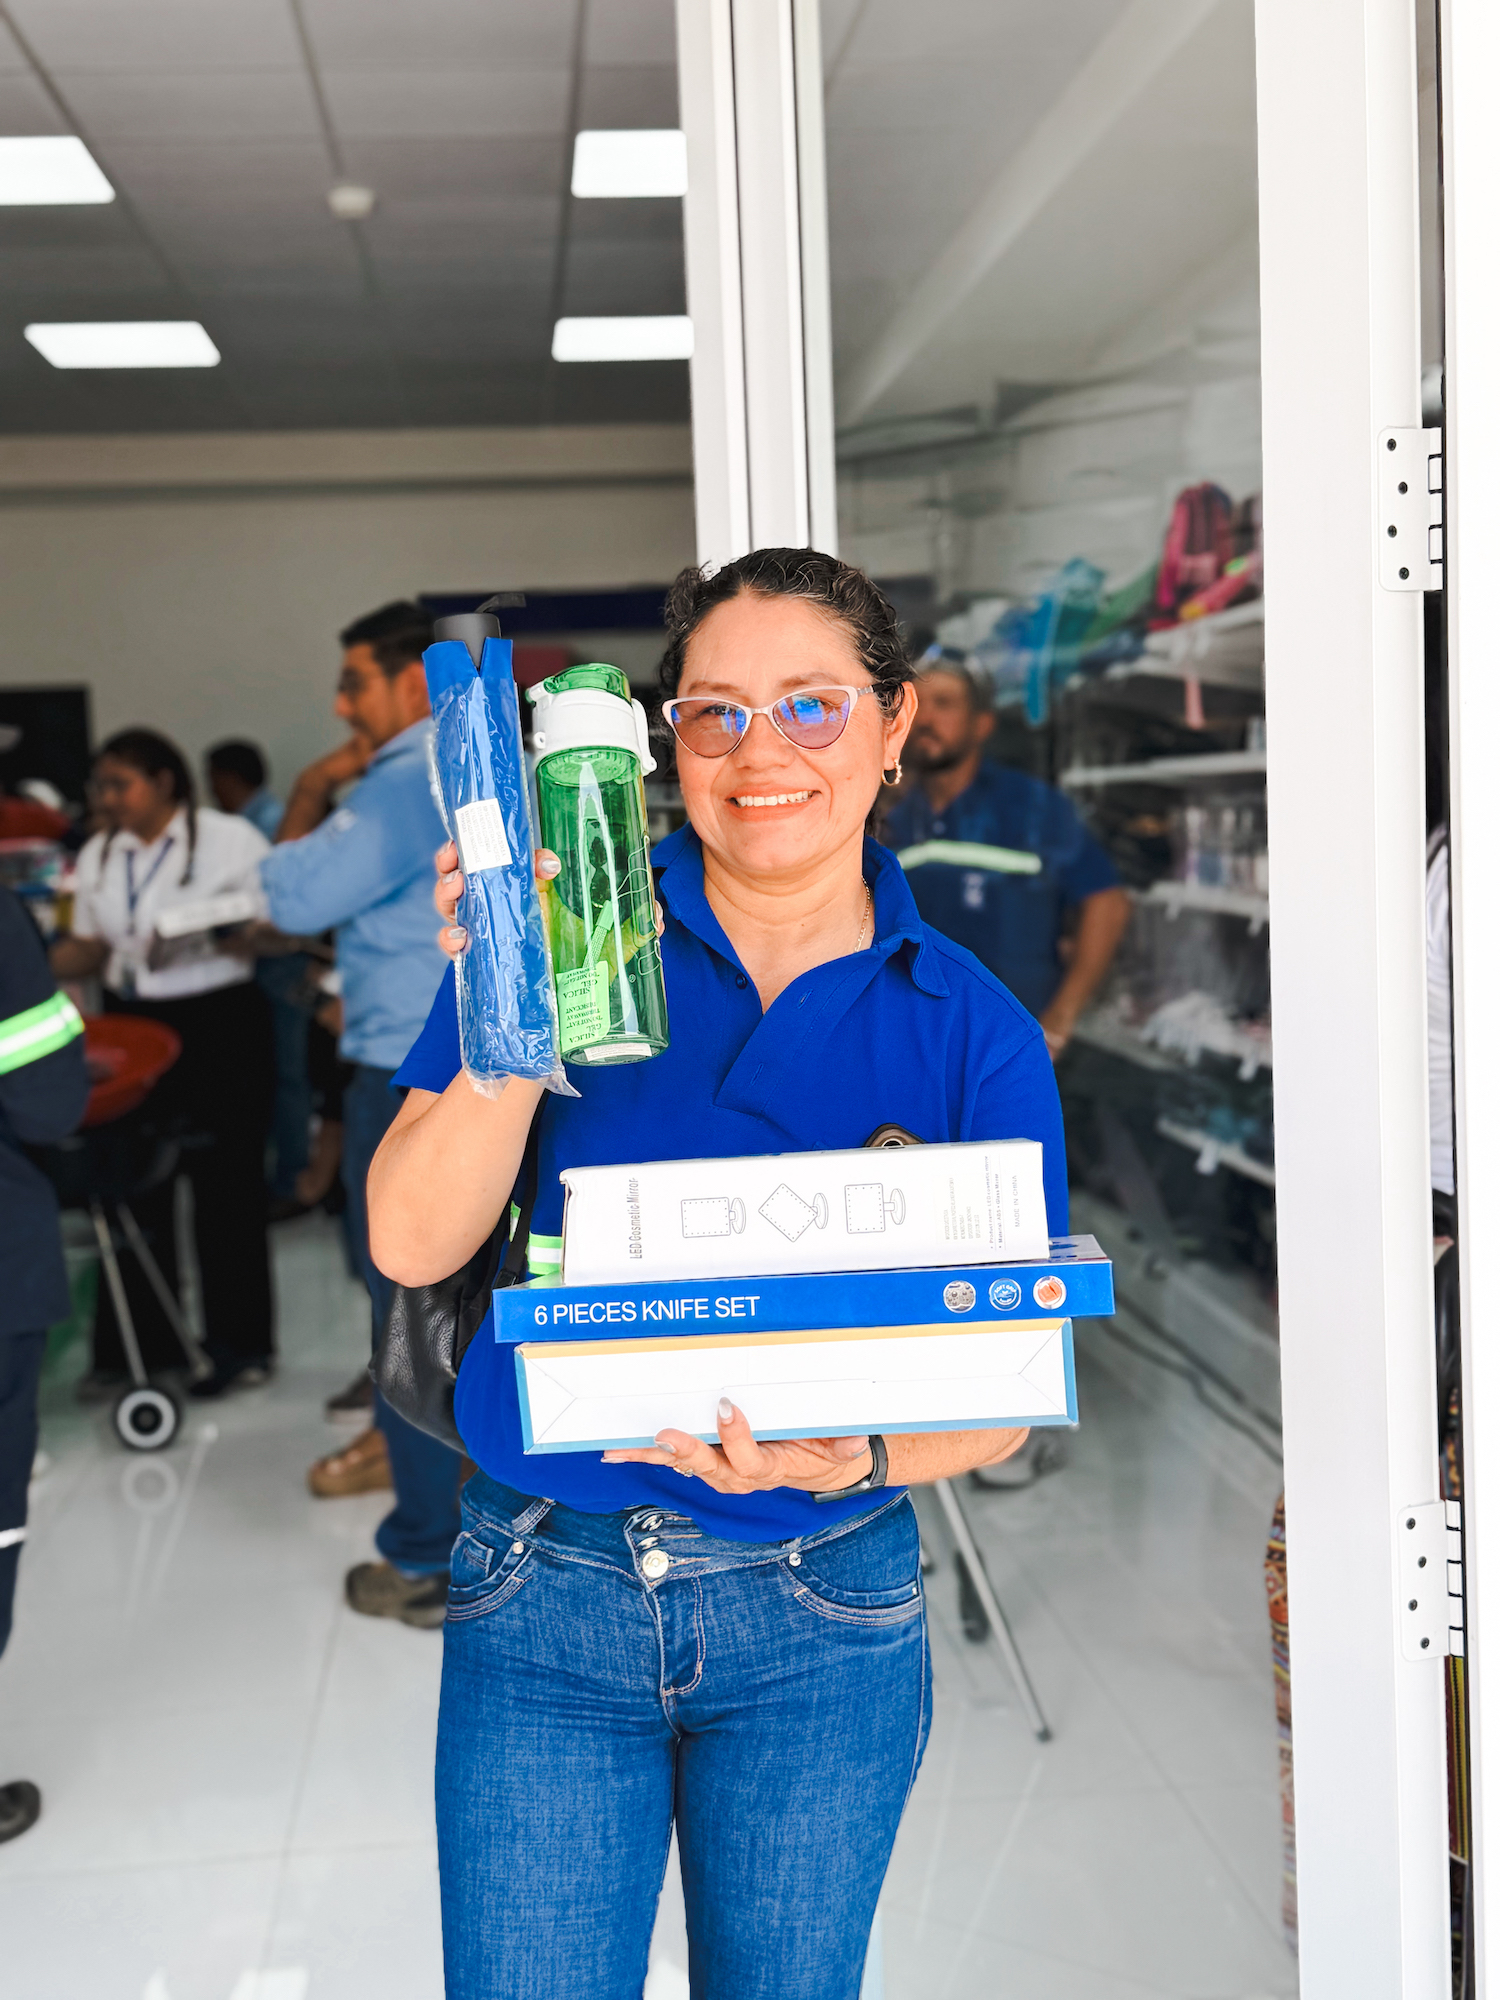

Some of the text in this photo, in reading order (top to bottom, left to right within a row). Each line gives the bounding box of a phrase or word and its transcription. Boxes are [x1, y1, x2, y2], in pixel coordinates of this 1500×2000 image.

[581, 979, 597, 987] GEL
[563, 987, 590, 998] SILICA
[586, 1023, 602, 1032] GEL
[569, 1032, 595, 1043] SILICA
[1013, 1198, 1019, 1206] IN
[626, 1177, 643, 1259] LED Cosmetic Mirror
[534, 1295, 761, 1326] 6 PIECES KNIFE SET
